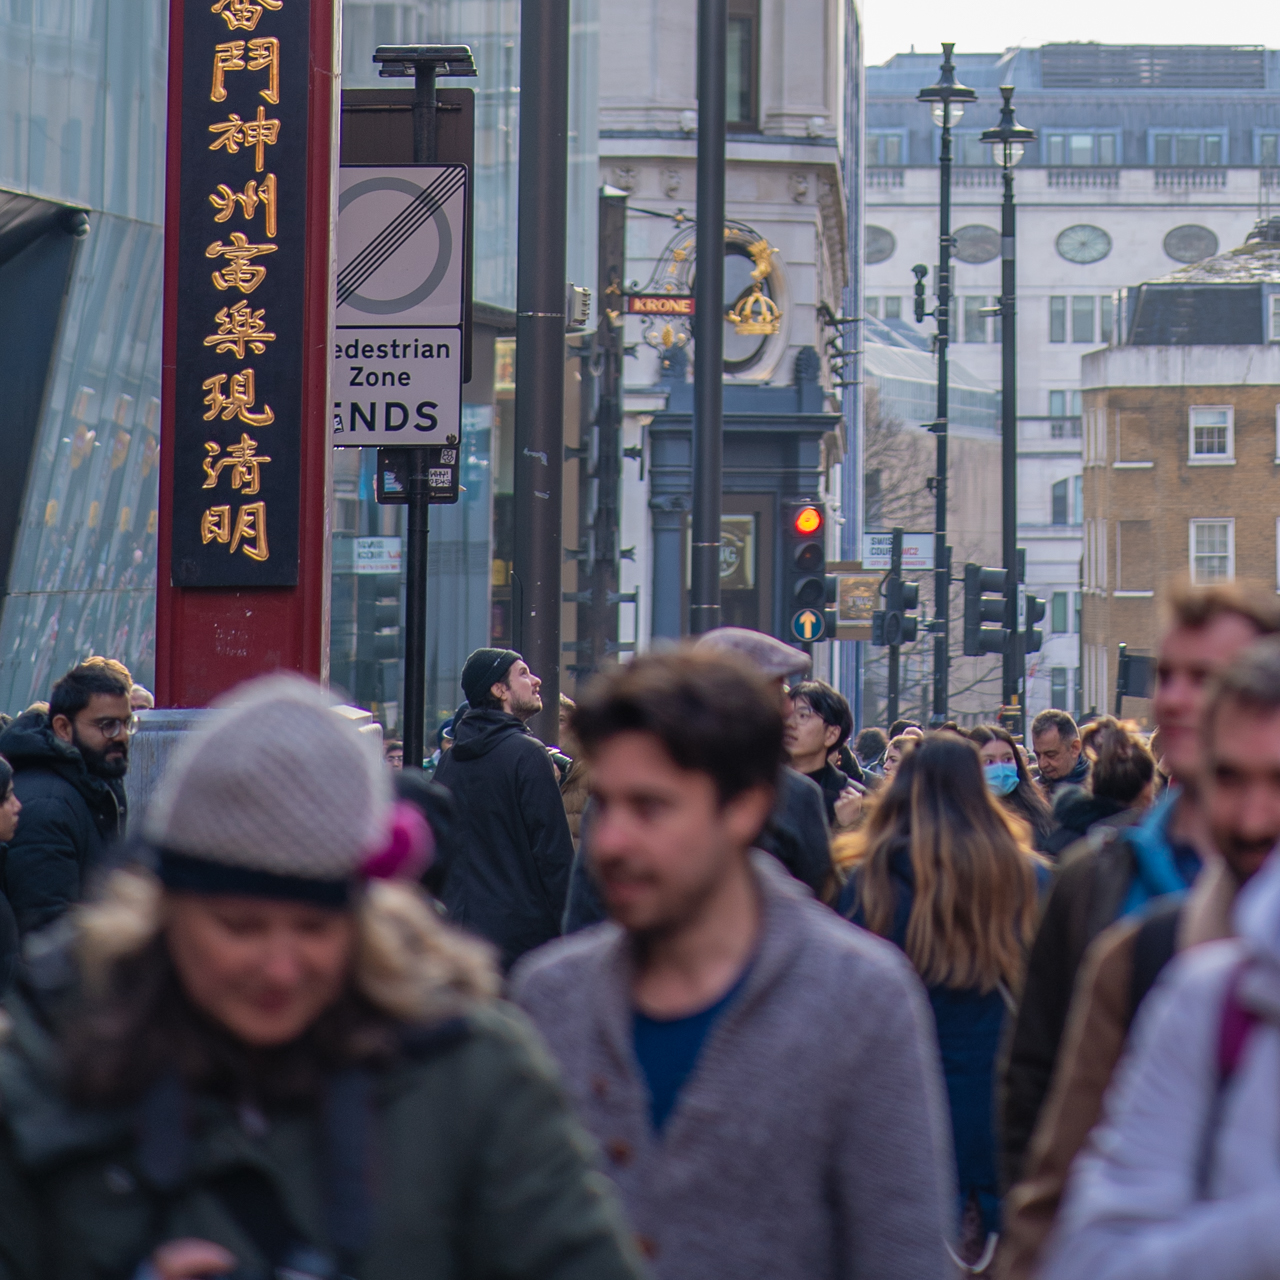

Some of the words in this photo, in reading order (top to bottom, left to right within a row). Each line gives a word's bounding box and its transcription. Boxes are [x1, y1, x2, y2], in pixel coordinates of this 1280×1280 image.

[633, 297, 692, 313] KRONE
[335, 337, 450, 360] edestrian
[349, 366, 412, 387] Zone
[870, 536, 893, 546] SWIS
